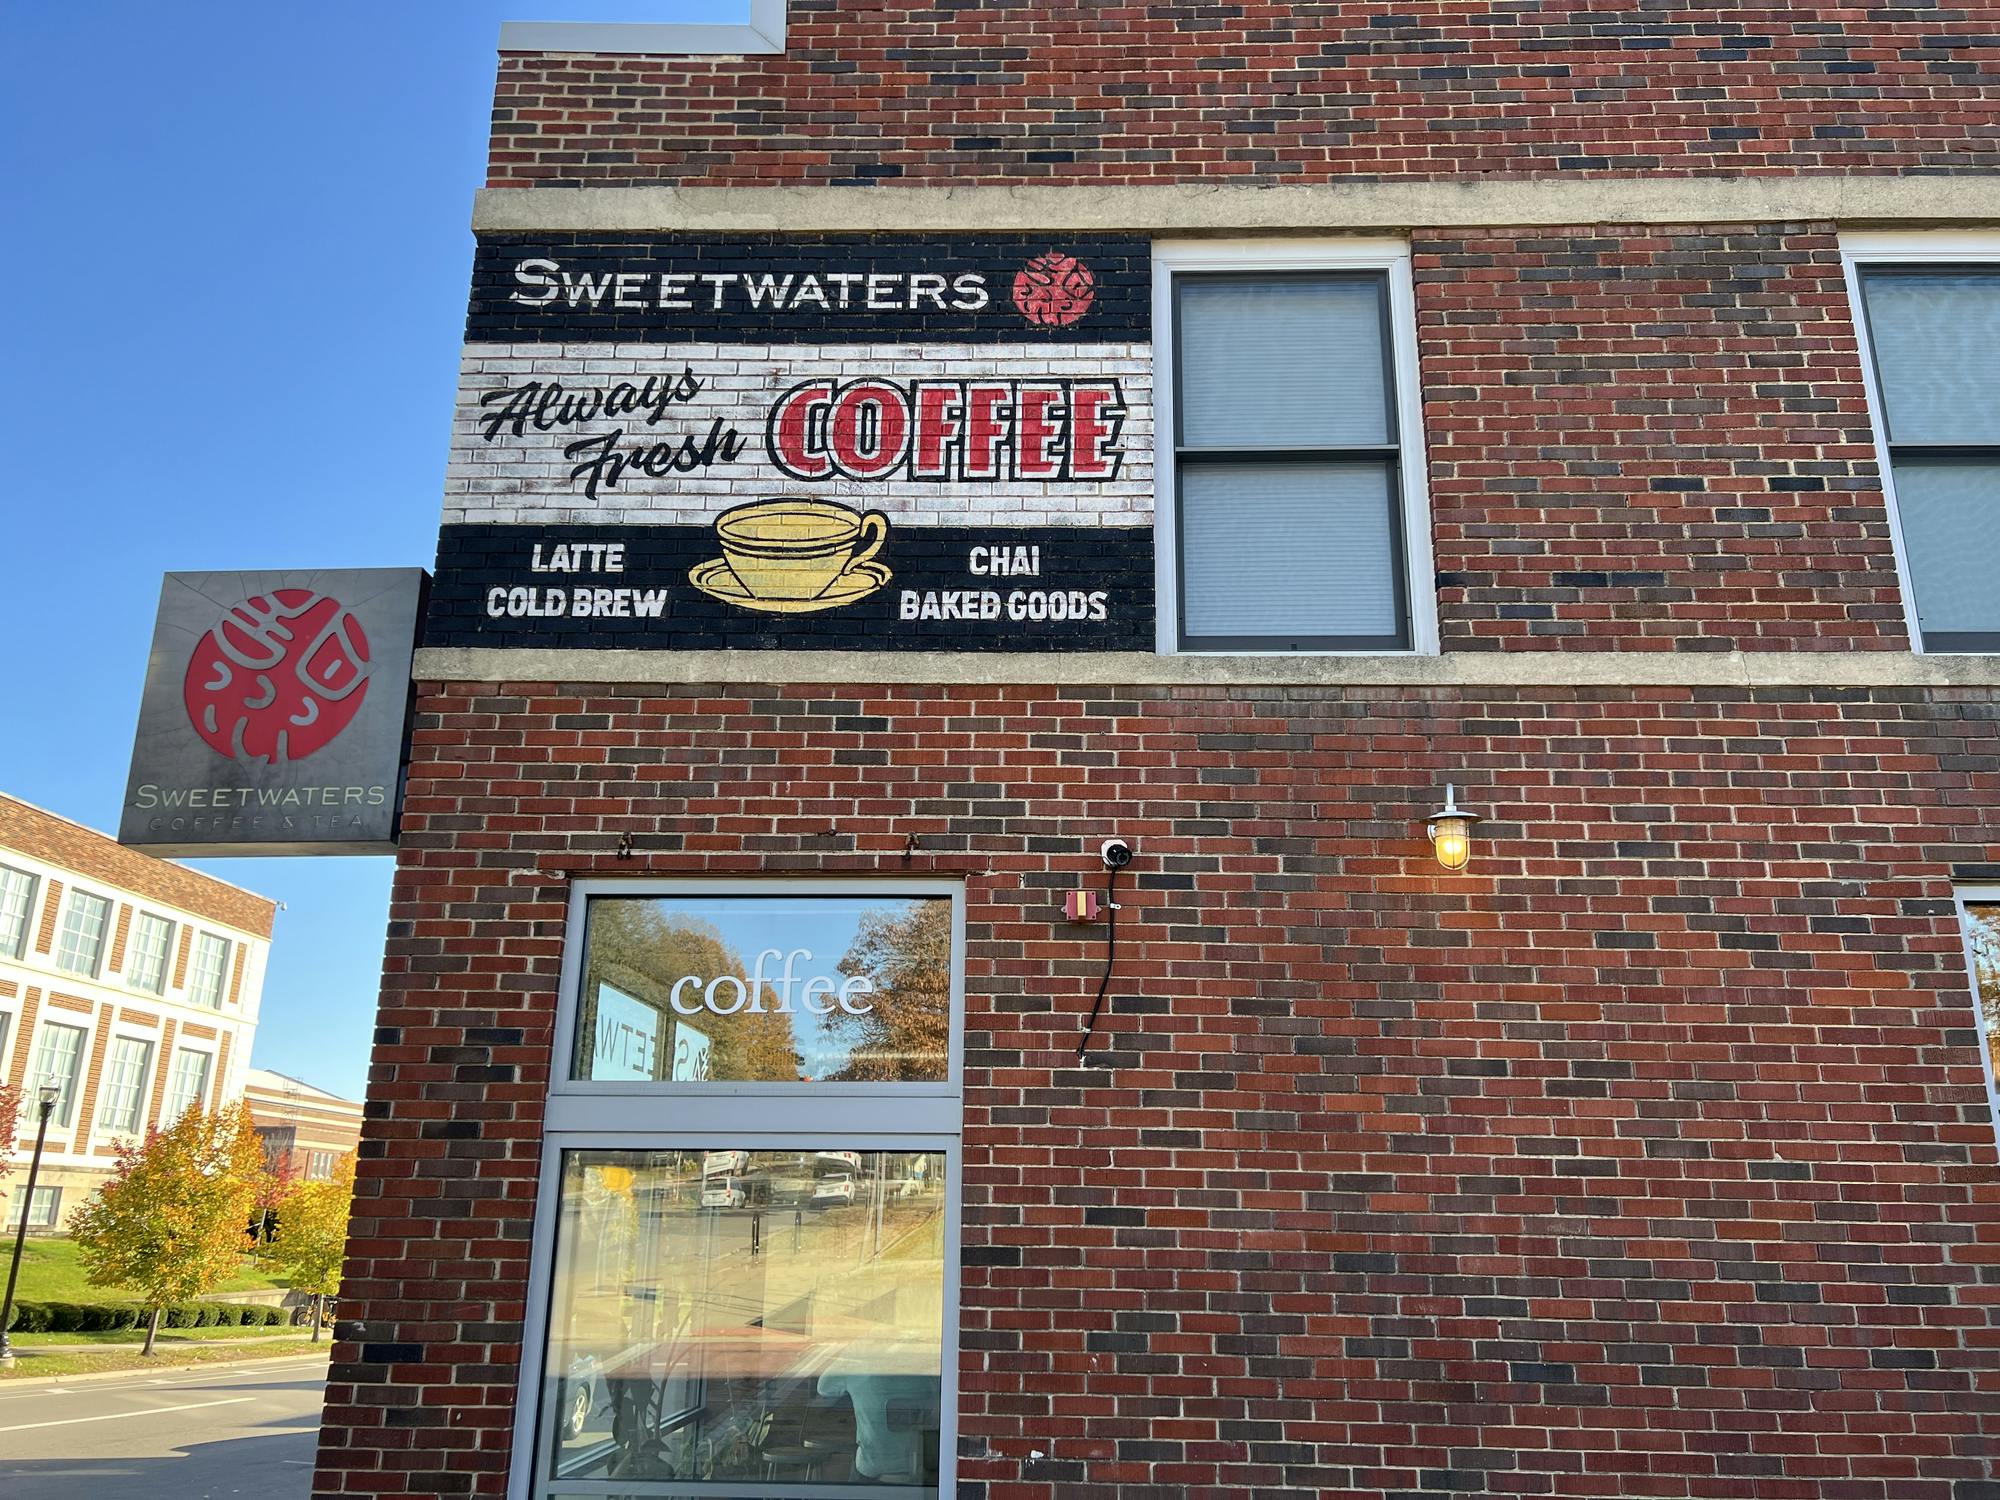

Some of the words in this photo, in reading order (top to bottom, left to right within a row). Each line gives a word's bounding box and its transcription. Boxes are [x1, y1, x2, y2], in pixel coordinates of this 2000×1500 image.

[509, 258, 990, 307] SWEETWATERS
[481, 368, 703, 440] Always
[766, 378, 1126, 482] COFFEE
[565, 418, 746, 499] Fresh
[531, 544, 625, 573] LATTE
[969, 545, 1040, 576] CHAI
[487, 588, 566, 617] COLD
[572, 589, 668, 618] BREW
[900, 591, 1001, 620] BAKED
[1007, 591, 1108, 620] GOODS
[135, 785, 385, 808] SWEETWATERS
[670, 949, 874, 1015] coffee
